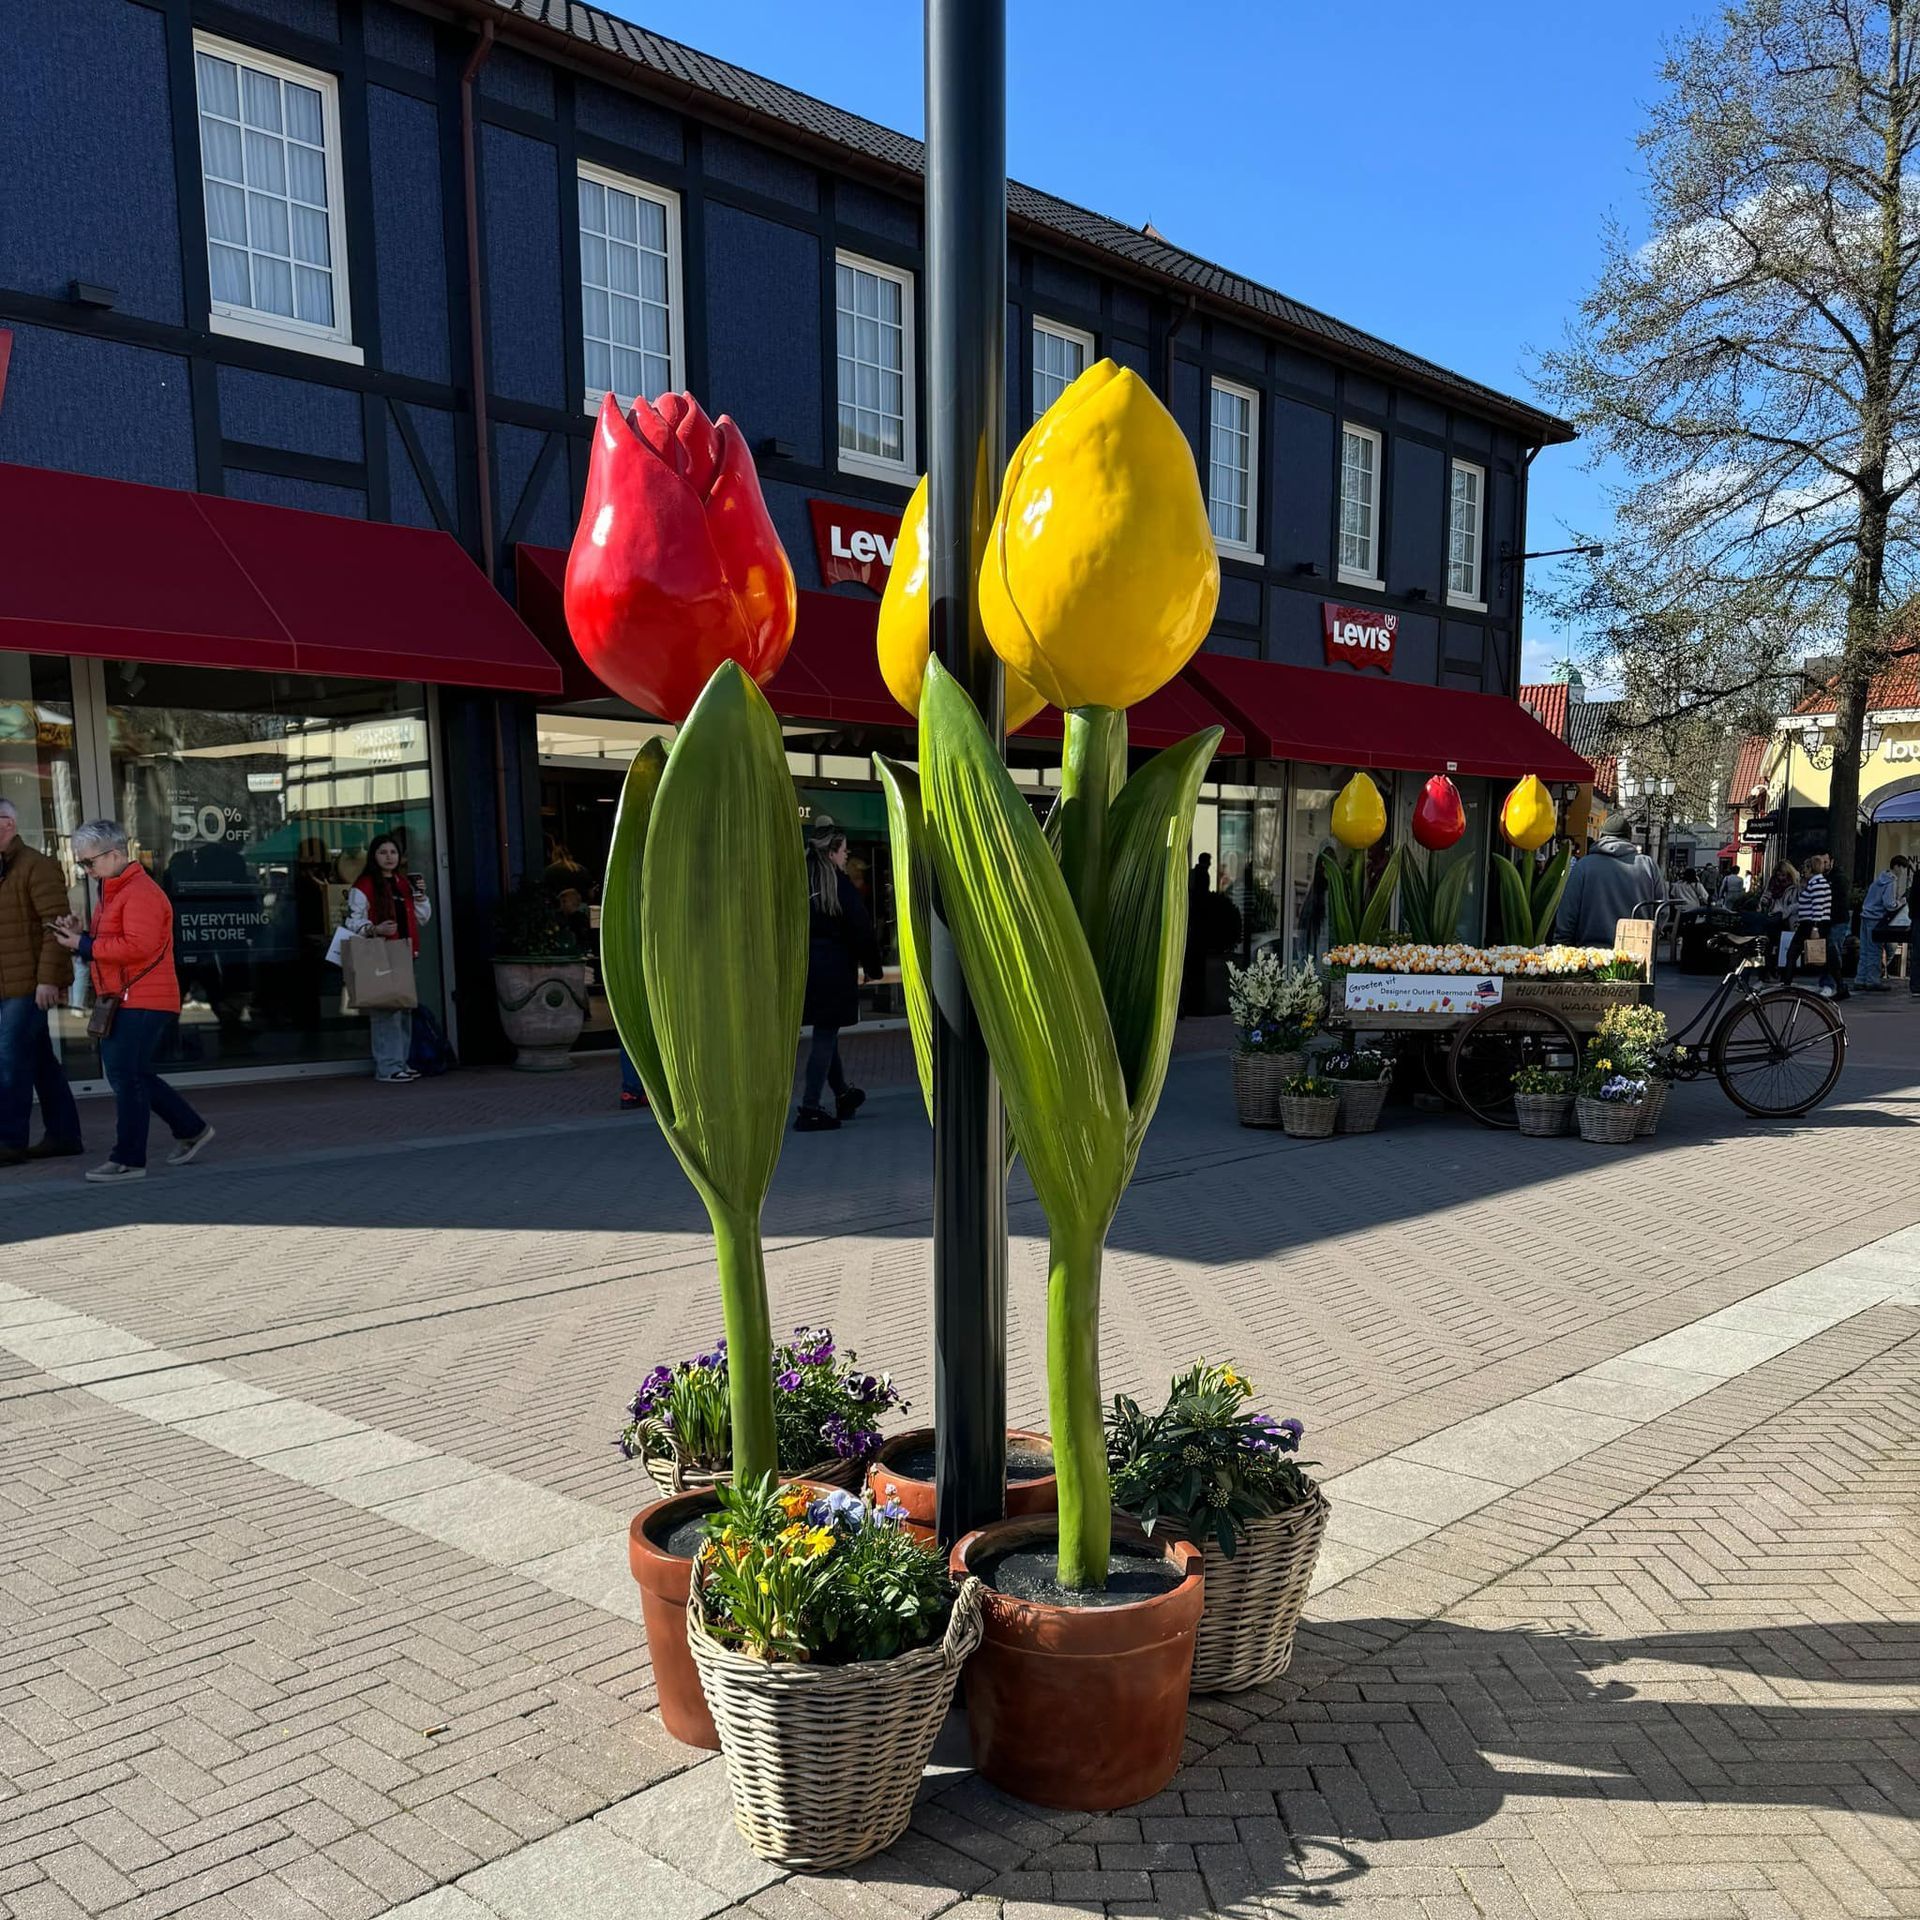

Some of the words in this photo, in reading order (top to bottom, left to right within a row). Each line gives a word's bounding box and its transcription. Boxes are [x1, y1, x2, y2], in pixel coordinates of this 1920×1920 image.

[226, 830, 250, 841] OFF
[181, 913, 270, 926] EVERYTHING
[182, 929, 197, 942] IN
[200, 928, 246, 941] STORE
[1348, 980, 1383, 993] Groeten
[1380, 988, 1410, 997] Designer
[1412, 988, 1435, 996] Outlet
[1436, 989, 1472, 997] Roermond
